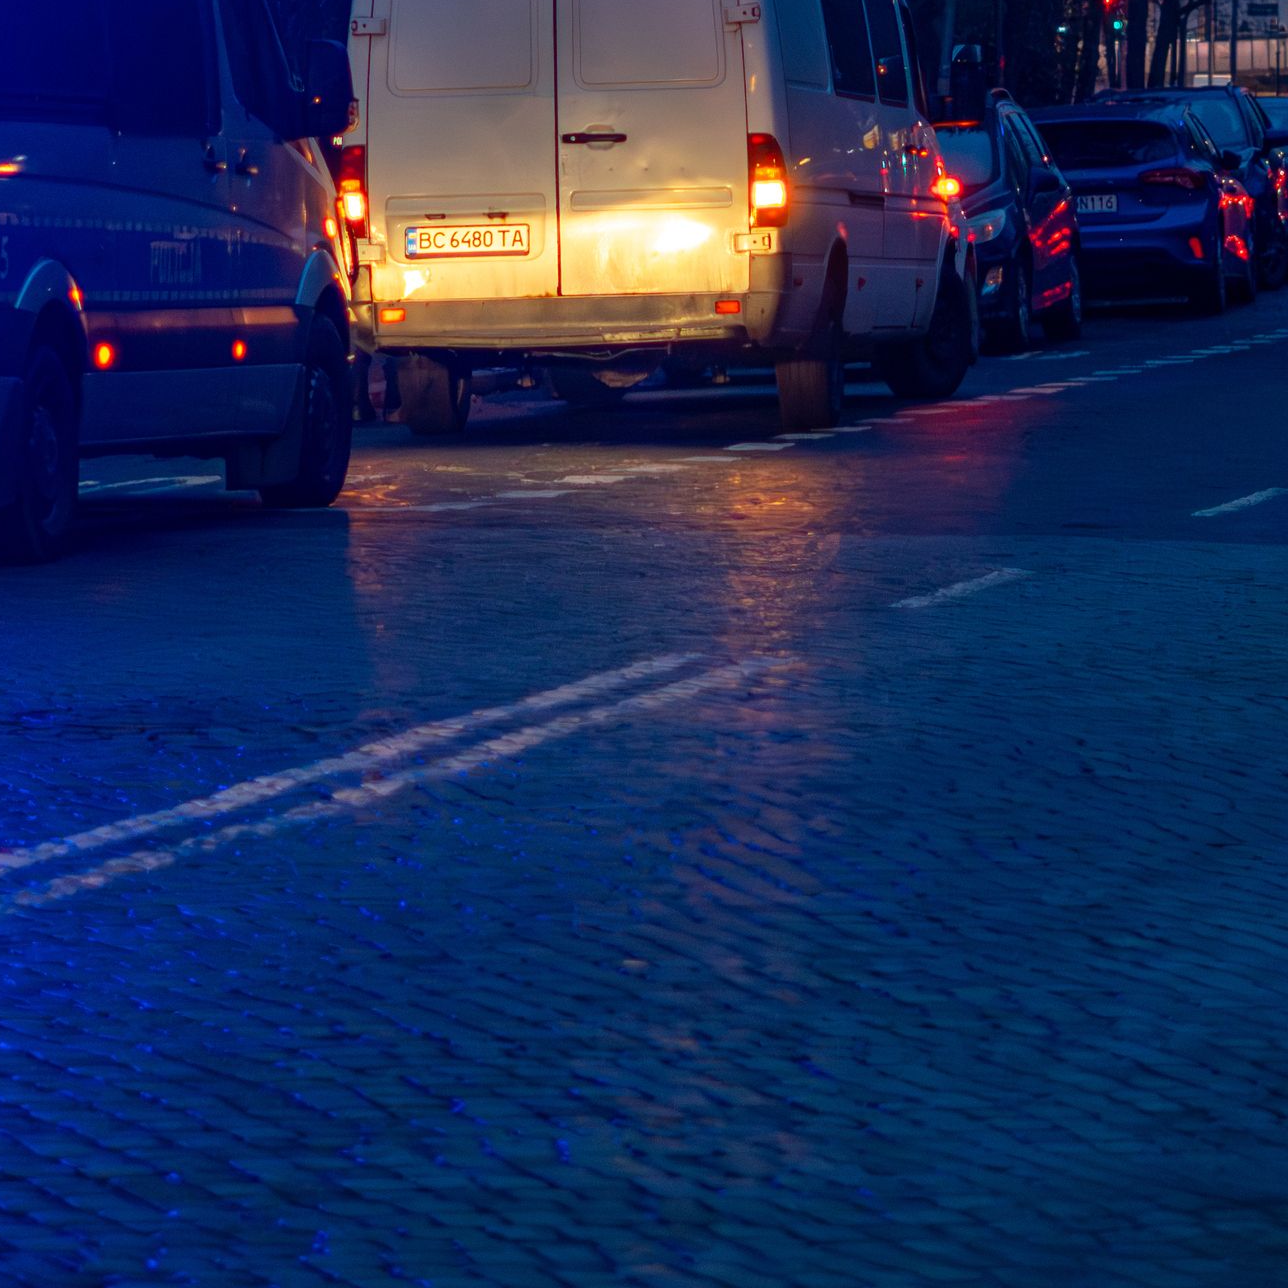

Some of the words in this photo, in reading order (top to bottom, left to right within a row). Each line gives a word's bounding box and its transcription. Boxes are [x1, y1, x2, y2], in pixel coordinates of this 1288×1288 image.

[419, 232, 446, 249] BC
[450, 230, 493, 248] 6480
[498, 230, 523, 246] TA
